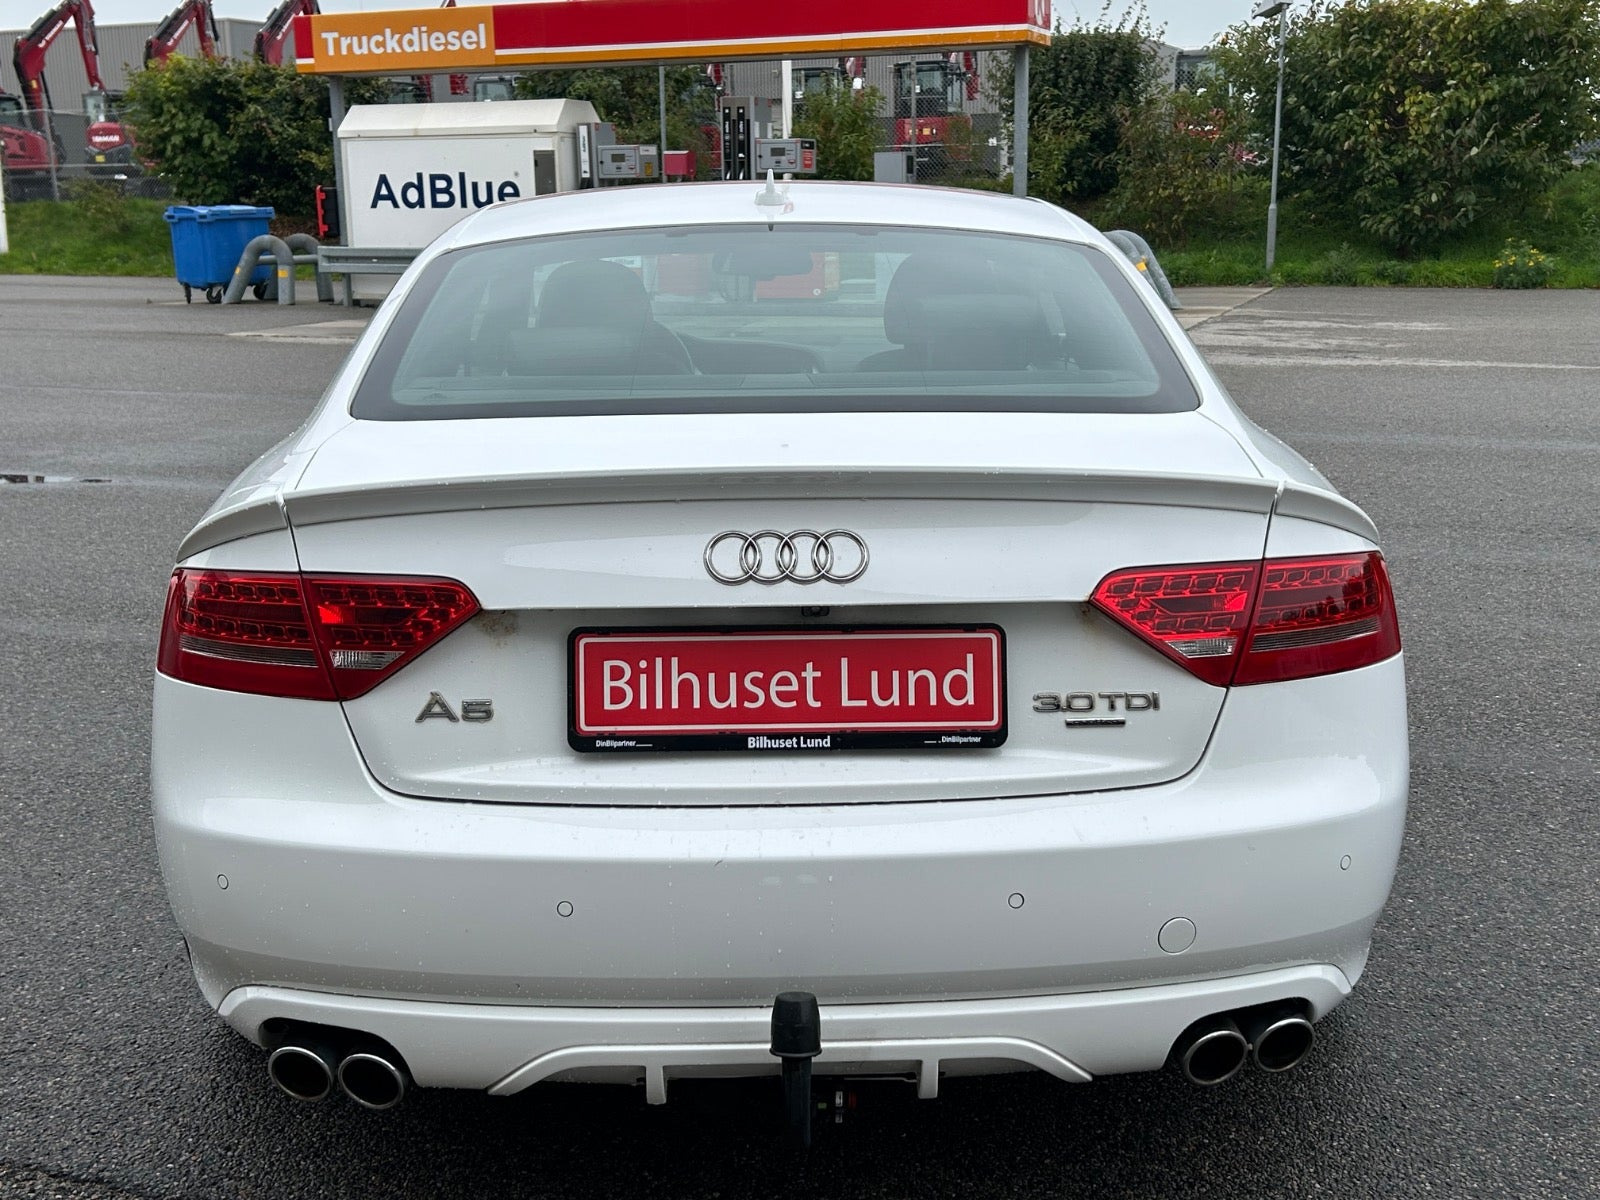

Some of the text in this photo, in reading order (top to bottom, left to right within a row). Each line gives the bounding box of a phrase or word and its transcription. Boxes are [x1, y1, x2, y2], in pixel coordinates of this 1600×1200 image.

[320, 23, 487, 56] Truckdiesel
[370, 172, 521, 209] AdBlue
[602, 653, 976, 711] Bilhuset Lund
[415, 690, 495, 724] A5
[1098, 691, 1161, 712] TDI
[747, 735, 831, 749] Bilhuset Lund
